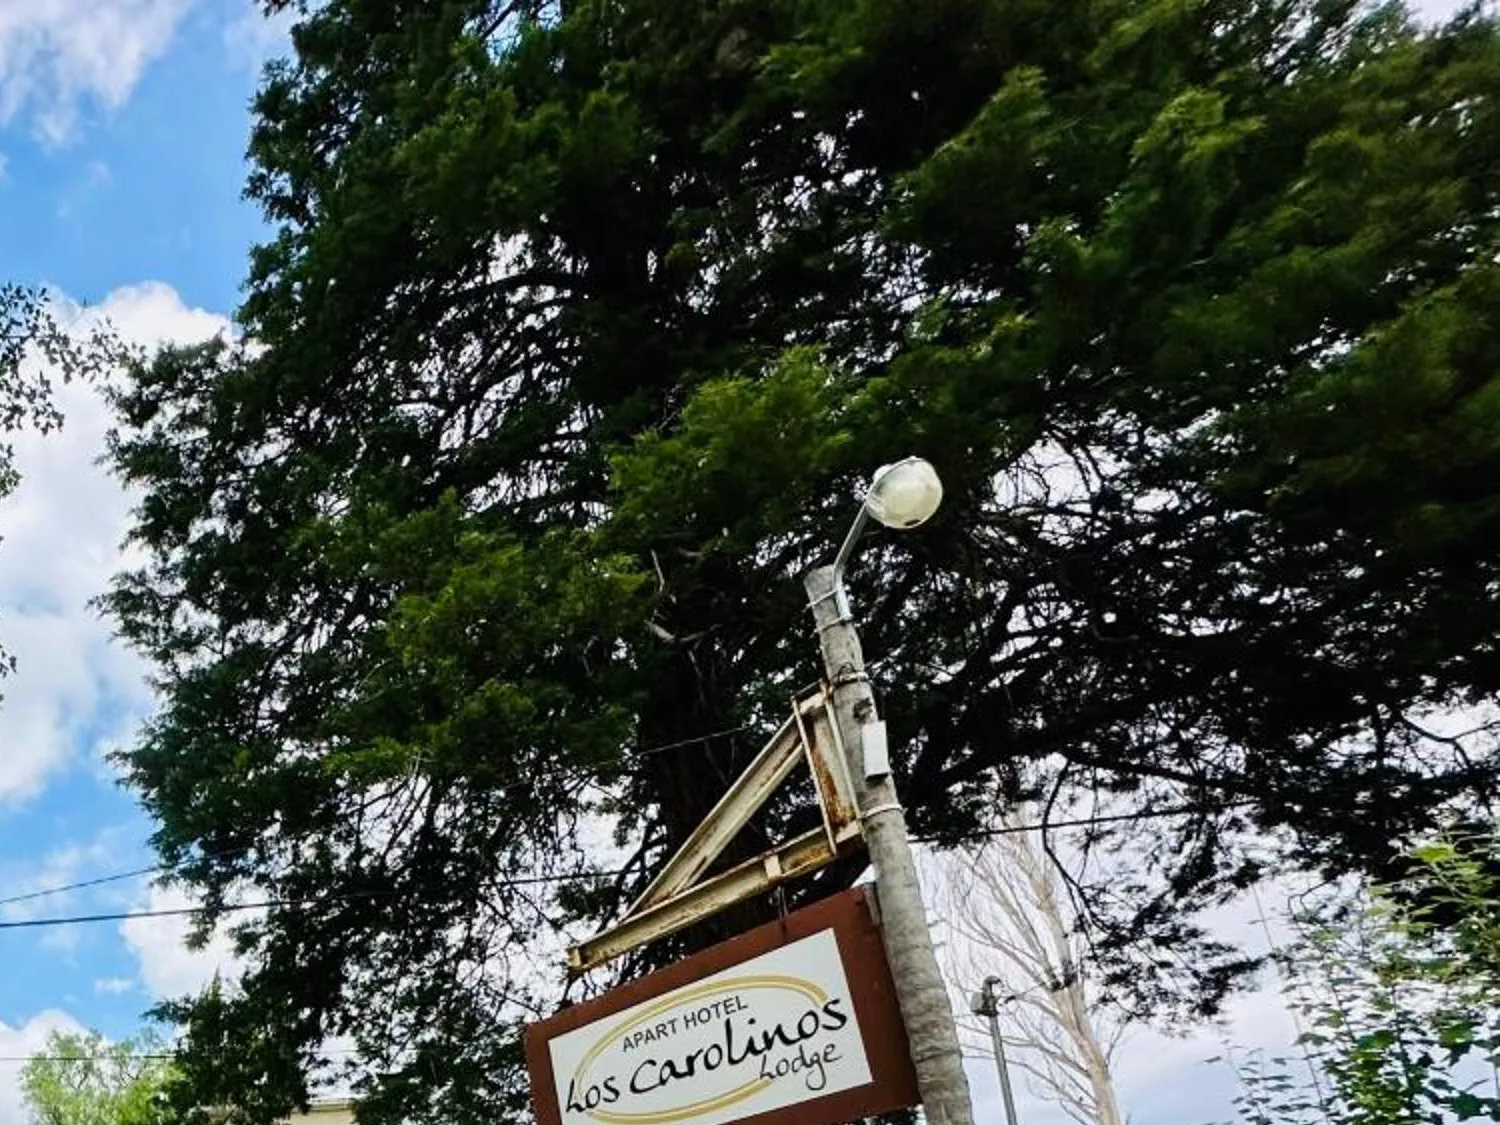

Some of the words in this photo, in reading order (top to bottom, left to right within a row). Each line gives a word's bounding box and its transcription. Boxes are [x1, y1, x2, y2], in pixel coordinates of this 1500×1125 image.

[622, 1018, 678, 1052] APART
[685, 995, 749, 1027] HOTEL
[566, 1075, 621, 1114] Los
[629, 998, 848, 1094] Carolinos
[758, 1042, 842, 1091] Lodge
